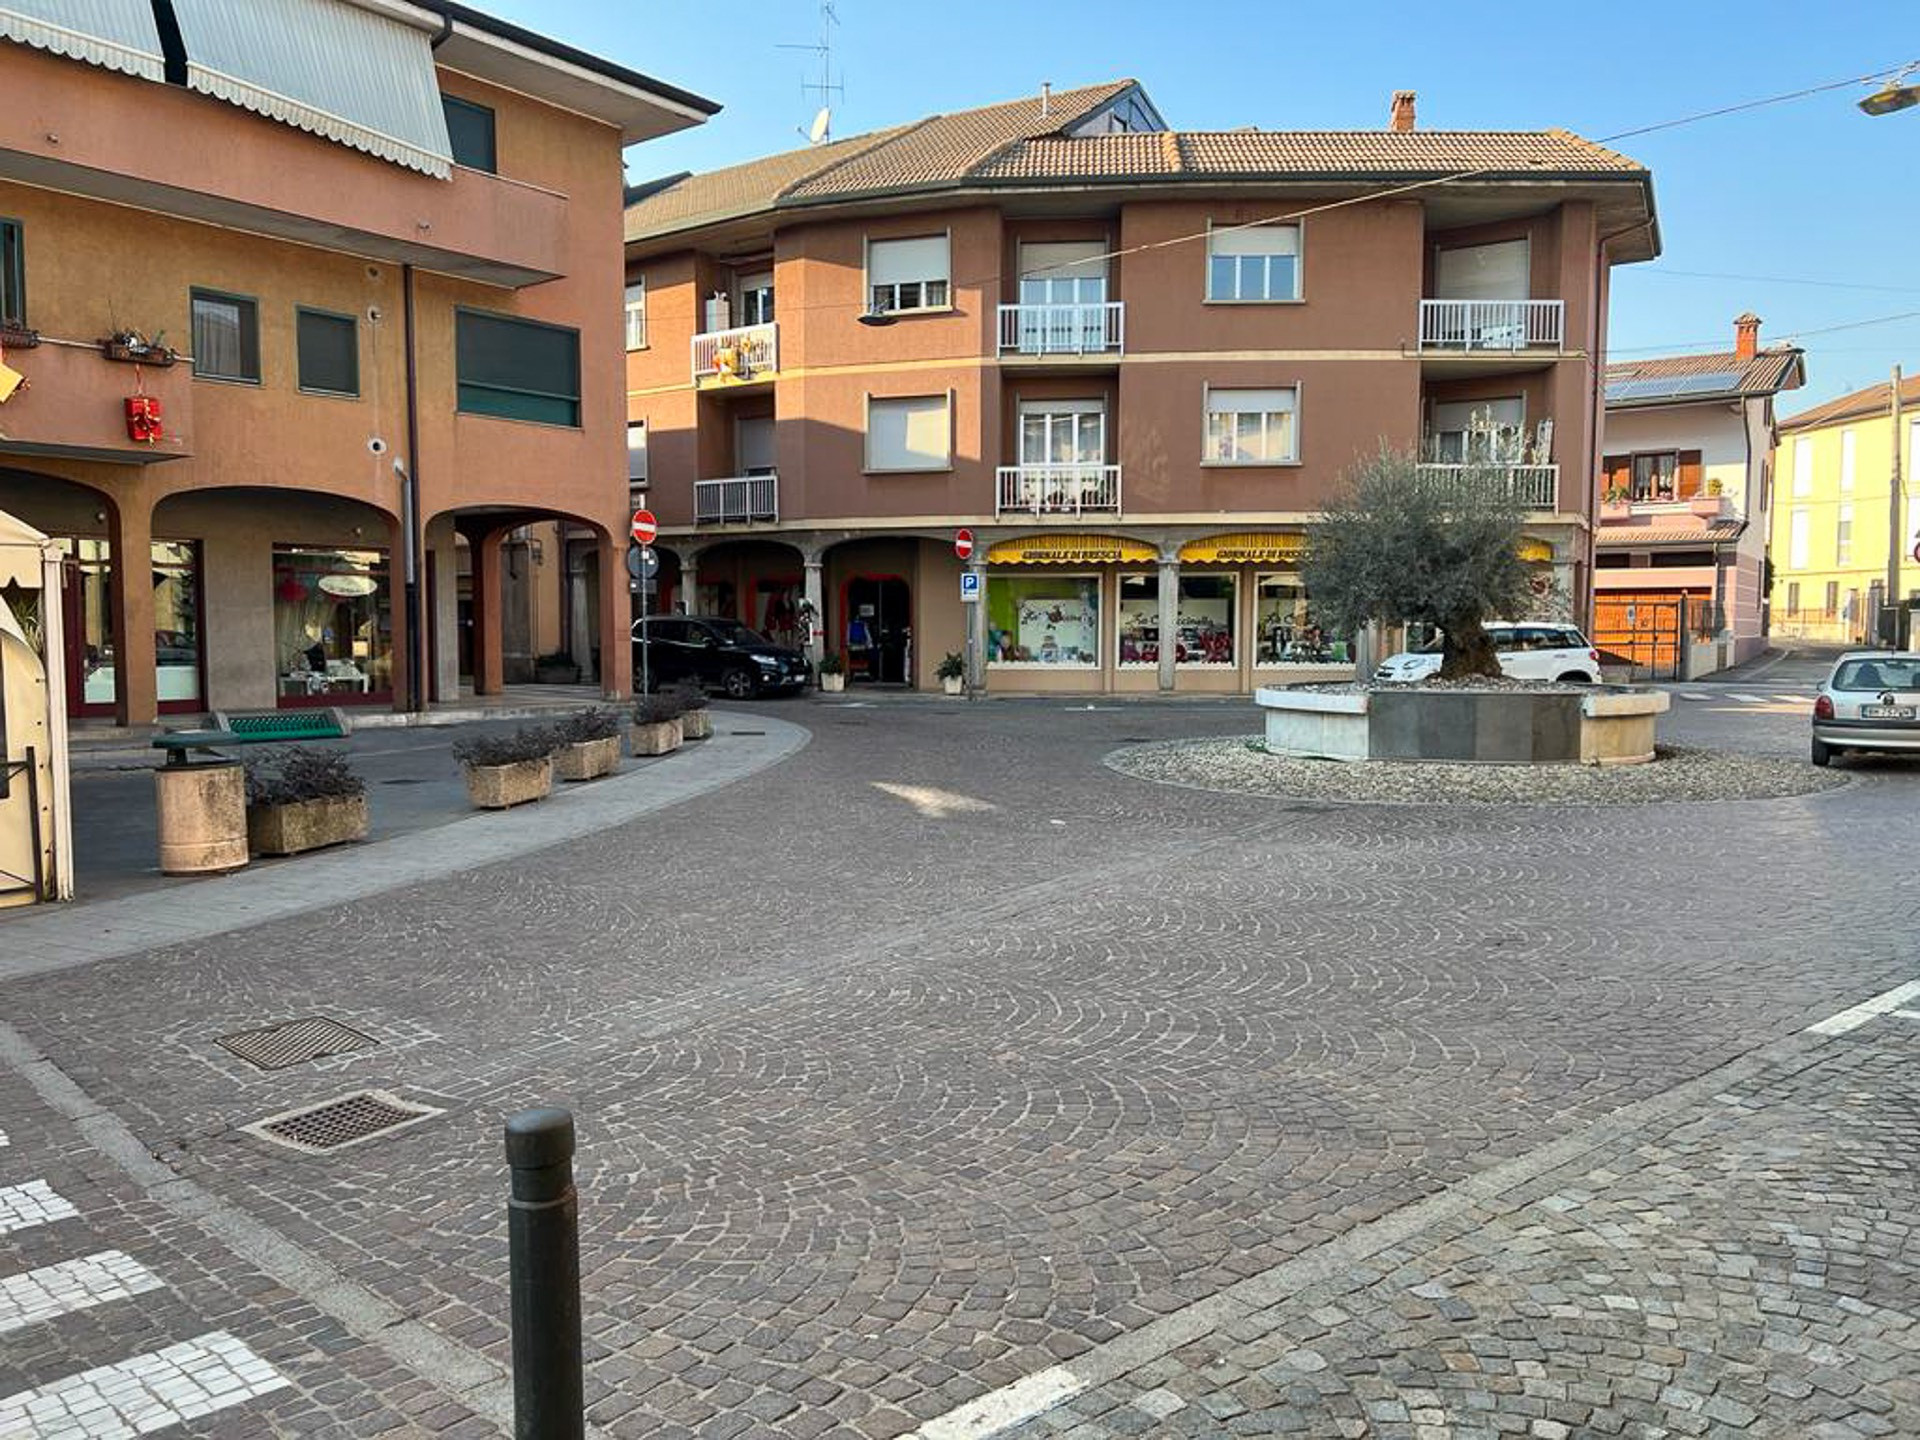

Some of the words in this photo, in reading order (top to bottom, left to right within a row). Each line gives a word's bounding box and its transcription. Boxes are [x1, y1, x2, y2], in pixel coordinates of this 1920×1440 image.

[1021, 550, 1070, 560] GIORNALE
[1081, 550, 1122, 560] BRESCIA
[965, 577, 975, 588] P
